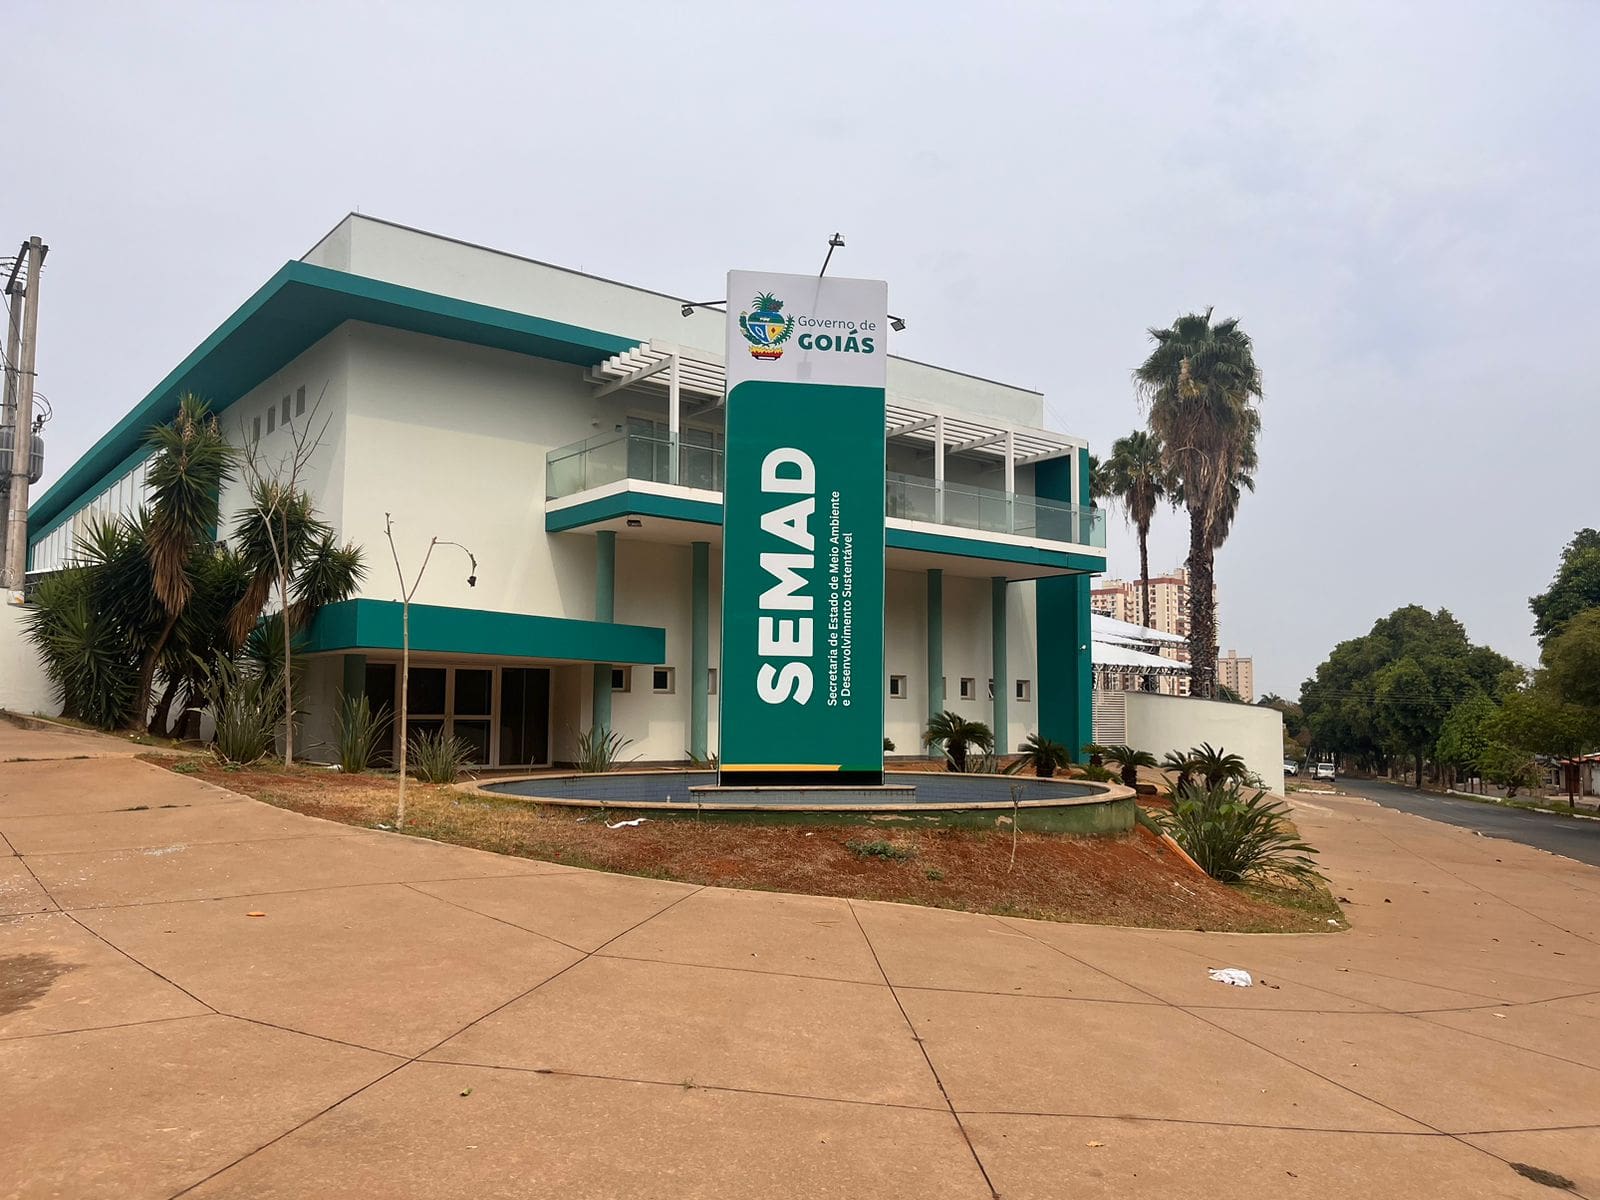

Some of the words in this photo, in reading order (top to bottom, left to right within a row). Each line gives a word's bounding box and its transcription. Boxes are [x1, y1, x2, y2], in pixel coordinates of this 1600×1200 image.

[798, 316, 855, 330] Governo
[860, 320, 876, 331] de
[798, 329, 875, 354] GOIÁS
[829, 490, 841, 545] Ambiente
[756, 447, 816, 706] SEMAD
[828, 546, 840, 574] Meio
[841, 532, 853, 598] Sustentável
[828, 575, 839, 590] de
[828, 592, 839, 630] Estado
[828, 632, 839, 647] de
[841, 599, 852, 697] Desenvolvimento
[827, 648, 839, 707] Secretaria
[842, 699, 851, 707] e
